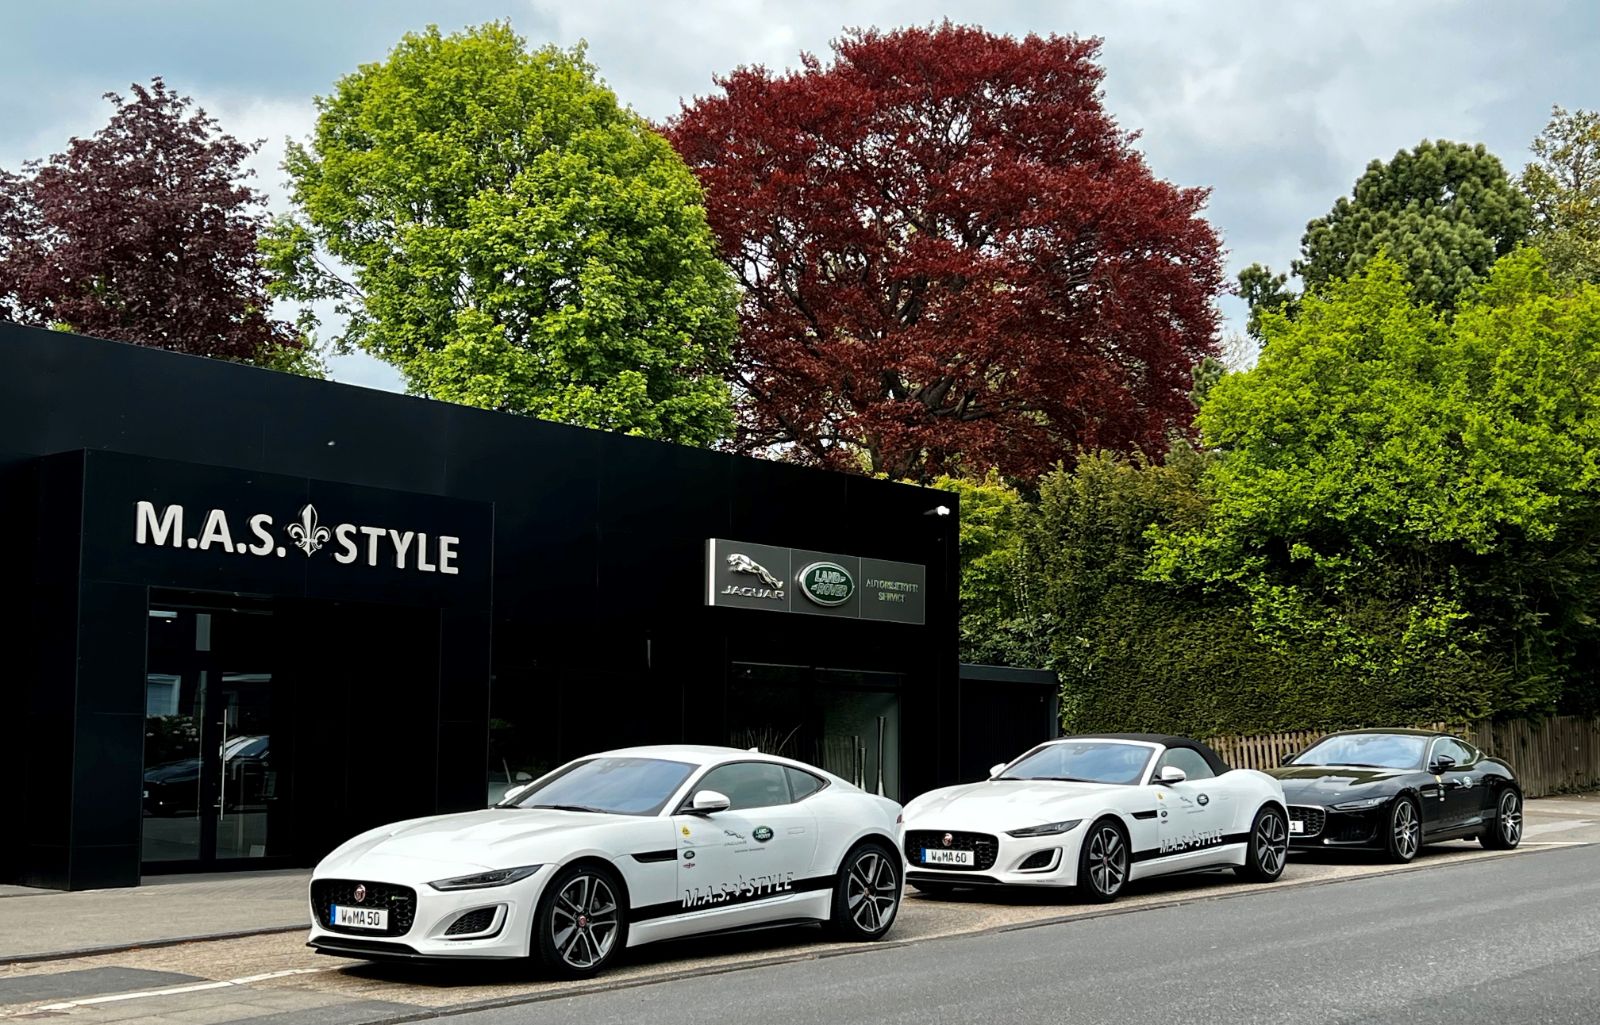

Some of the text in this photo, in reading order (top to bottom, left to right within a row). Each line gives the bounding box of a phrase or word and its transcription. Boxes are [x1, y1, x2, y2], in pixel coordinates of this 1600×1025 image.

[136, 500, 460, 575] M.A.S. STYLE
[814, 570, 841, 583] LAND
[721, 585, 785, 600] JAGUAR
[816, 582, 848, 597] ROVER
[682, 871, 794, 909] M.A.S. STYLE
[367, 911, 380, 926] 50
